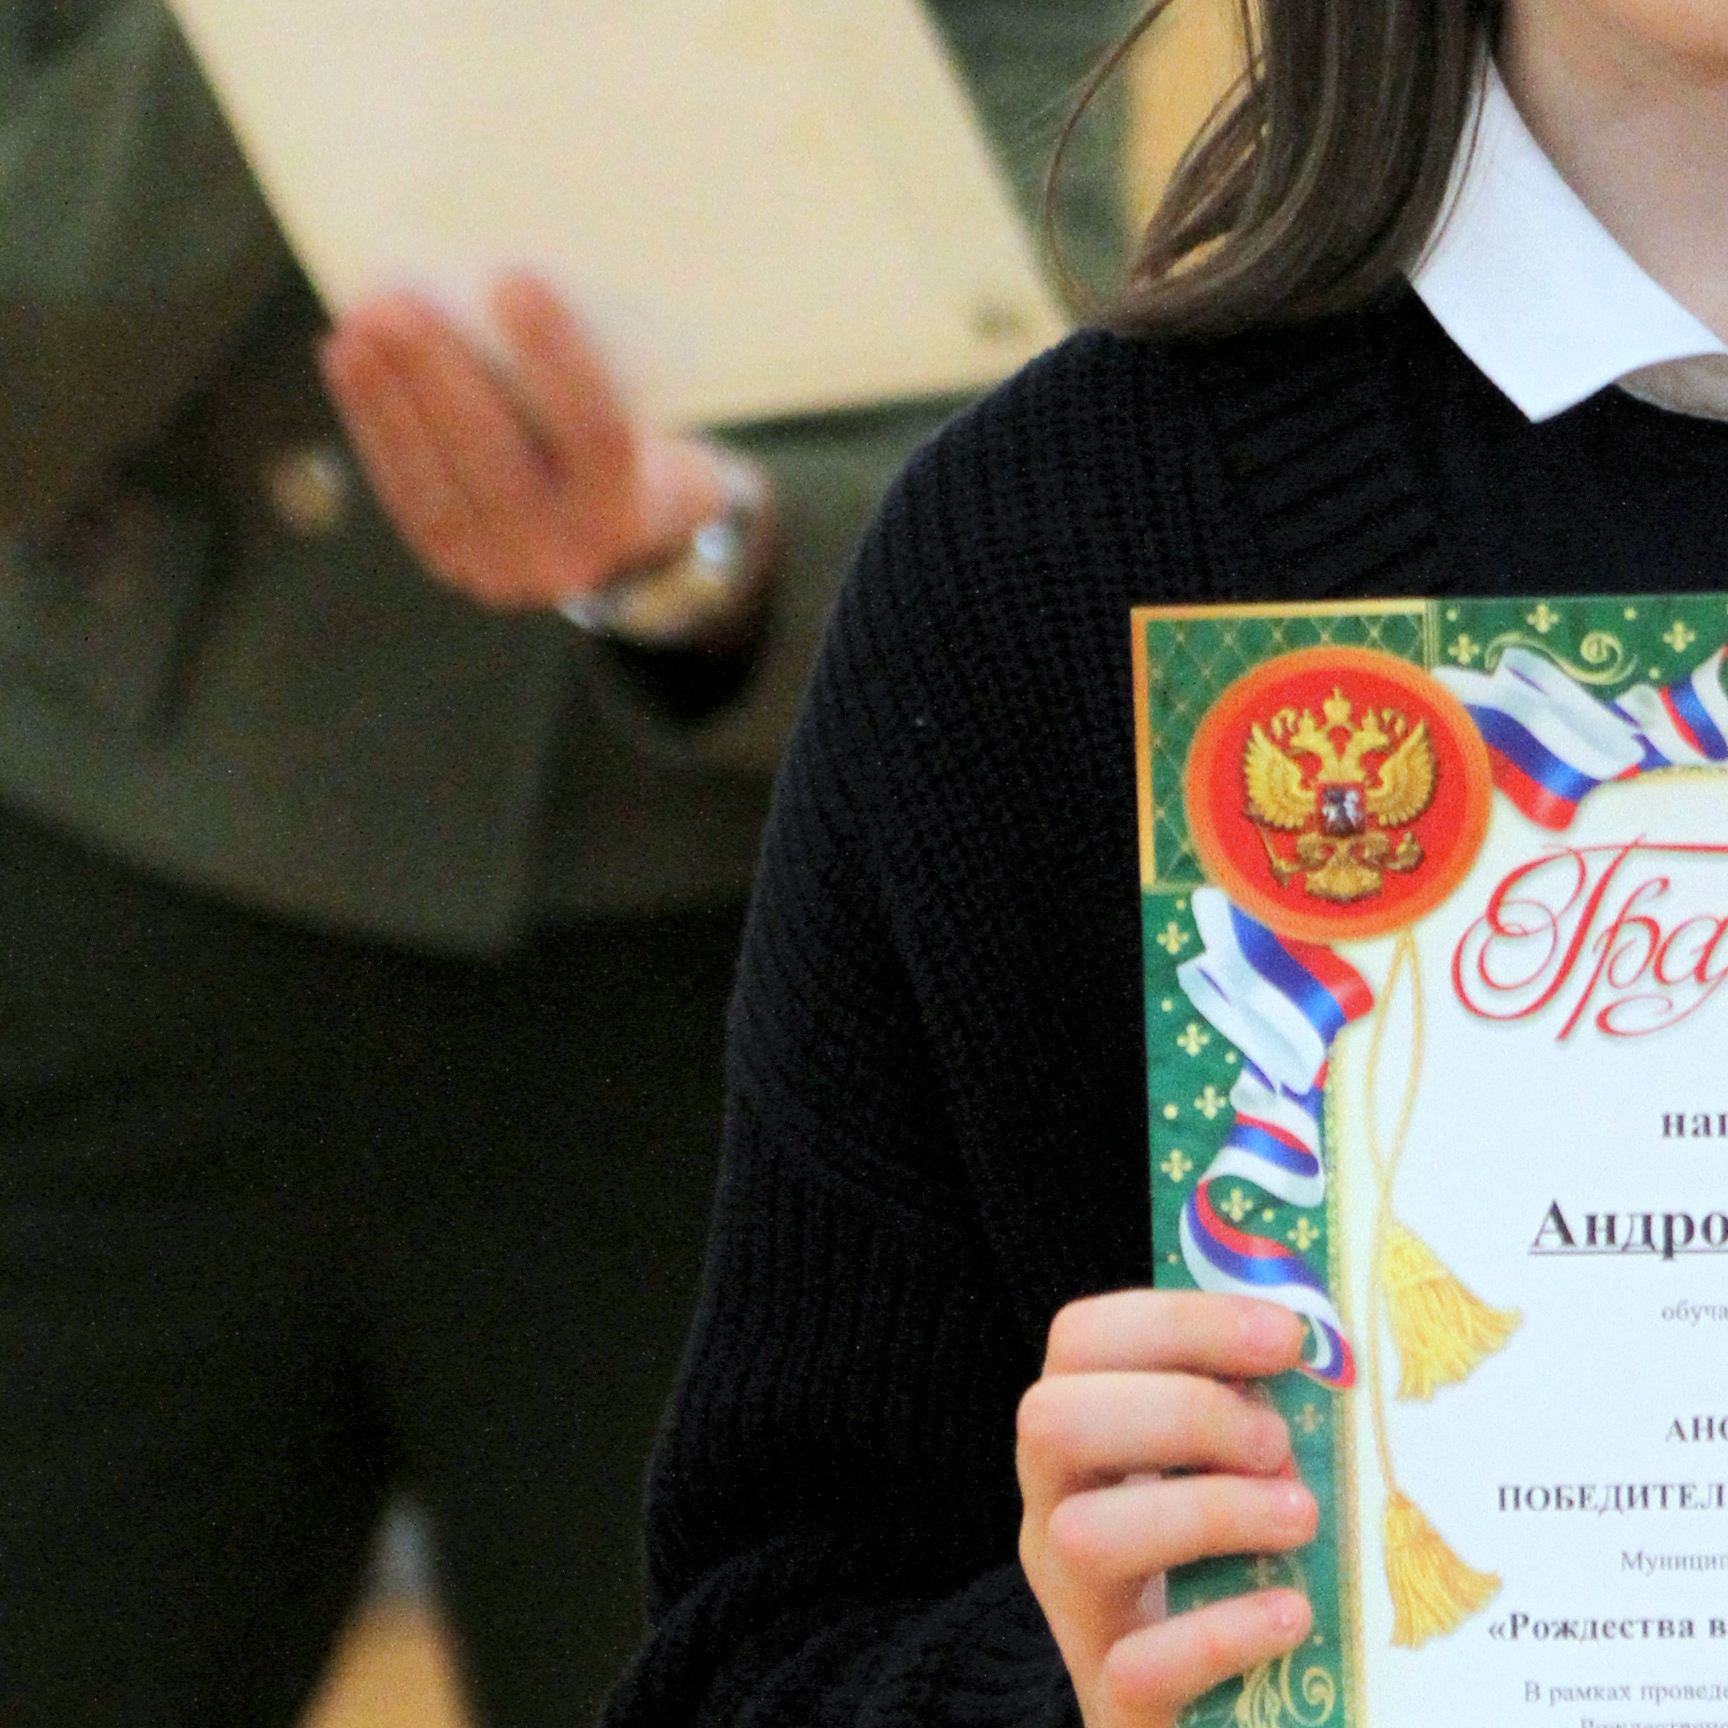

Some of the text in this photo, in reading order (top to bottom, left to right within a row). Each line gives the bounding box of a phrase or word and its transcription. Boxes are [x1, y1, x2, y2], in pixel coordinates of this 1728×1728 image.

[1488, 1611, 1695, 1642] «Рождества
[1523, 1679, 1542, 1703] В
[1548, 1684, 1632, 1708] рамках
